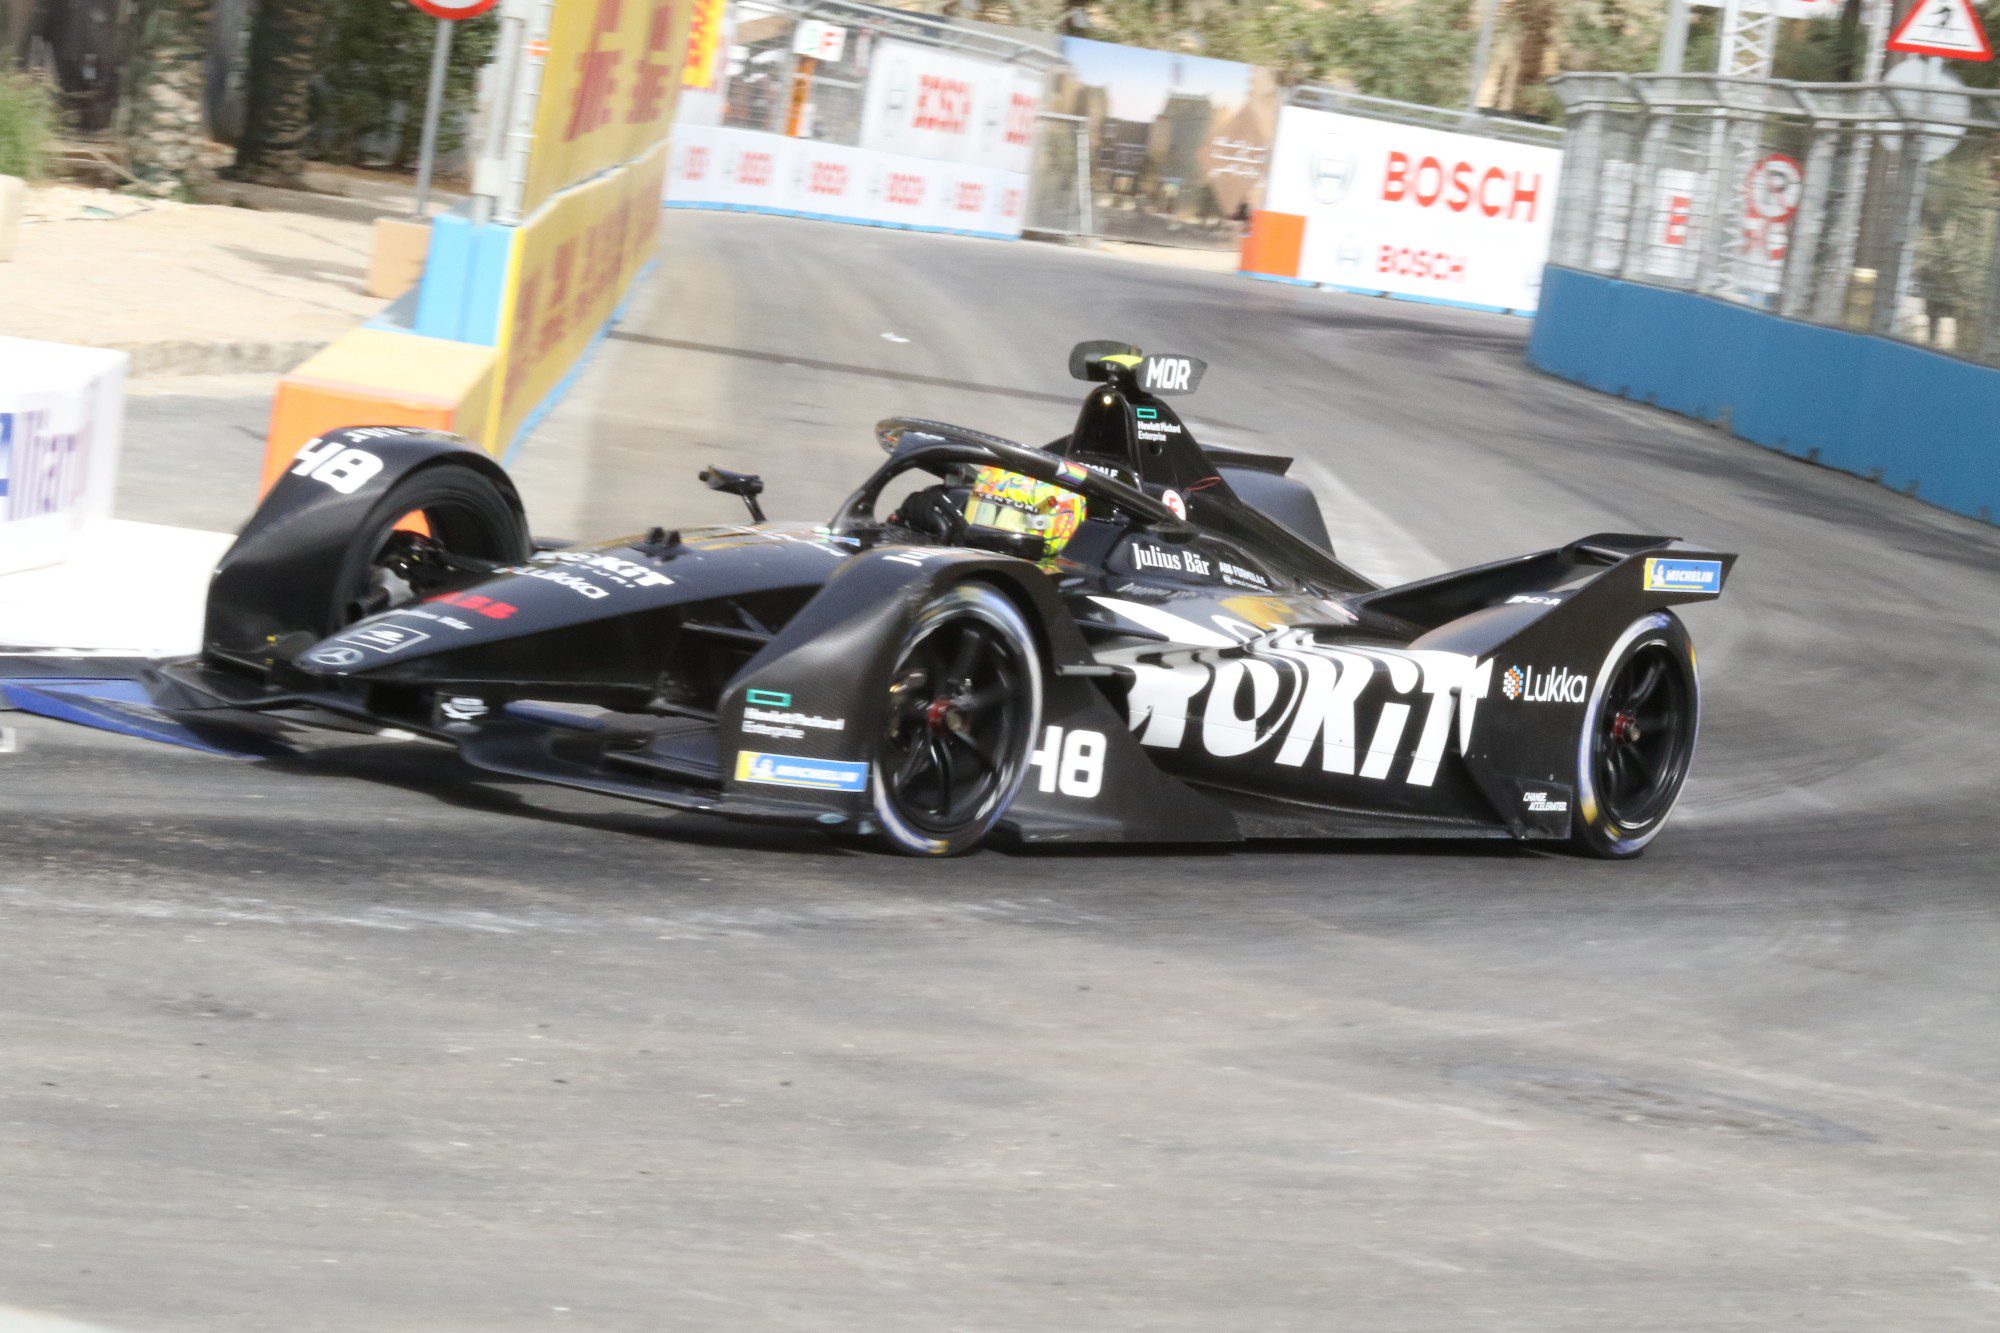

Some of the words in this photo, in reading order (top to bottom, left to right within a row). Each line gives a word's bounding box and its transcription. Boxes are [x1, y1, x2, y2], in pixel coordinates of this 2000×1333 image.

[1382, 150, 1542, 222] BOSCH
[1377, 244, 1466, 283] BOSCH
[1145, 357, 1191, 390] MOR
[290, 437, 384, 494] 48
[1131, 542, 1182, 571] Julius
[1182, 550, 1210, 576] Bär
[1665, 570, 1714, 583] MICHELIN
[1523, 664, 1588, 703] Lukka
